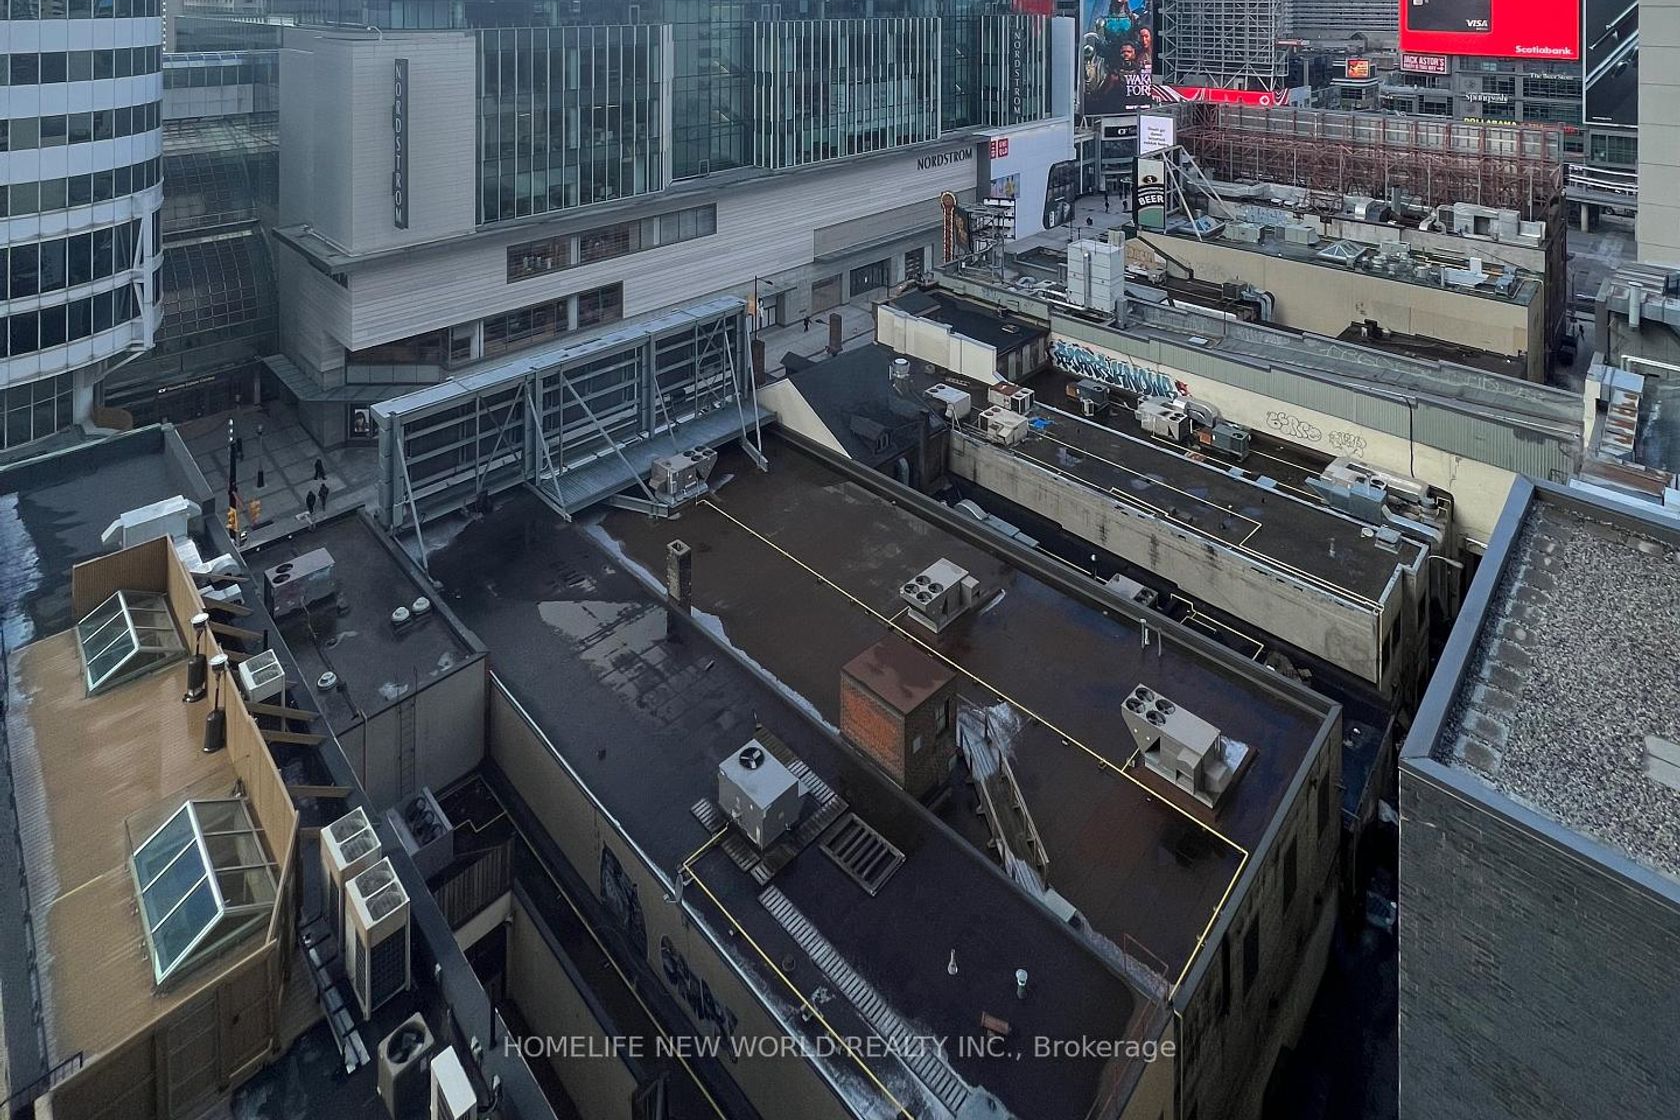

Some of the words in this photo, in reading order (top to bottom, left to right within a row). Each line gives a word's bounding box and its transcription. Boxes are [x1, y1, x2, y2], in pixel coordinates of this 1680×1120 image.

[1466, 19, 1488, 27] VISA
[1515, 45, 1572, 55] Scotiabank
[1013, 31, 1021, 115] NORDSTROM
[916, 147, 973, 171] NORDSTROM
[1138, 194, 1164, 206] BEER
